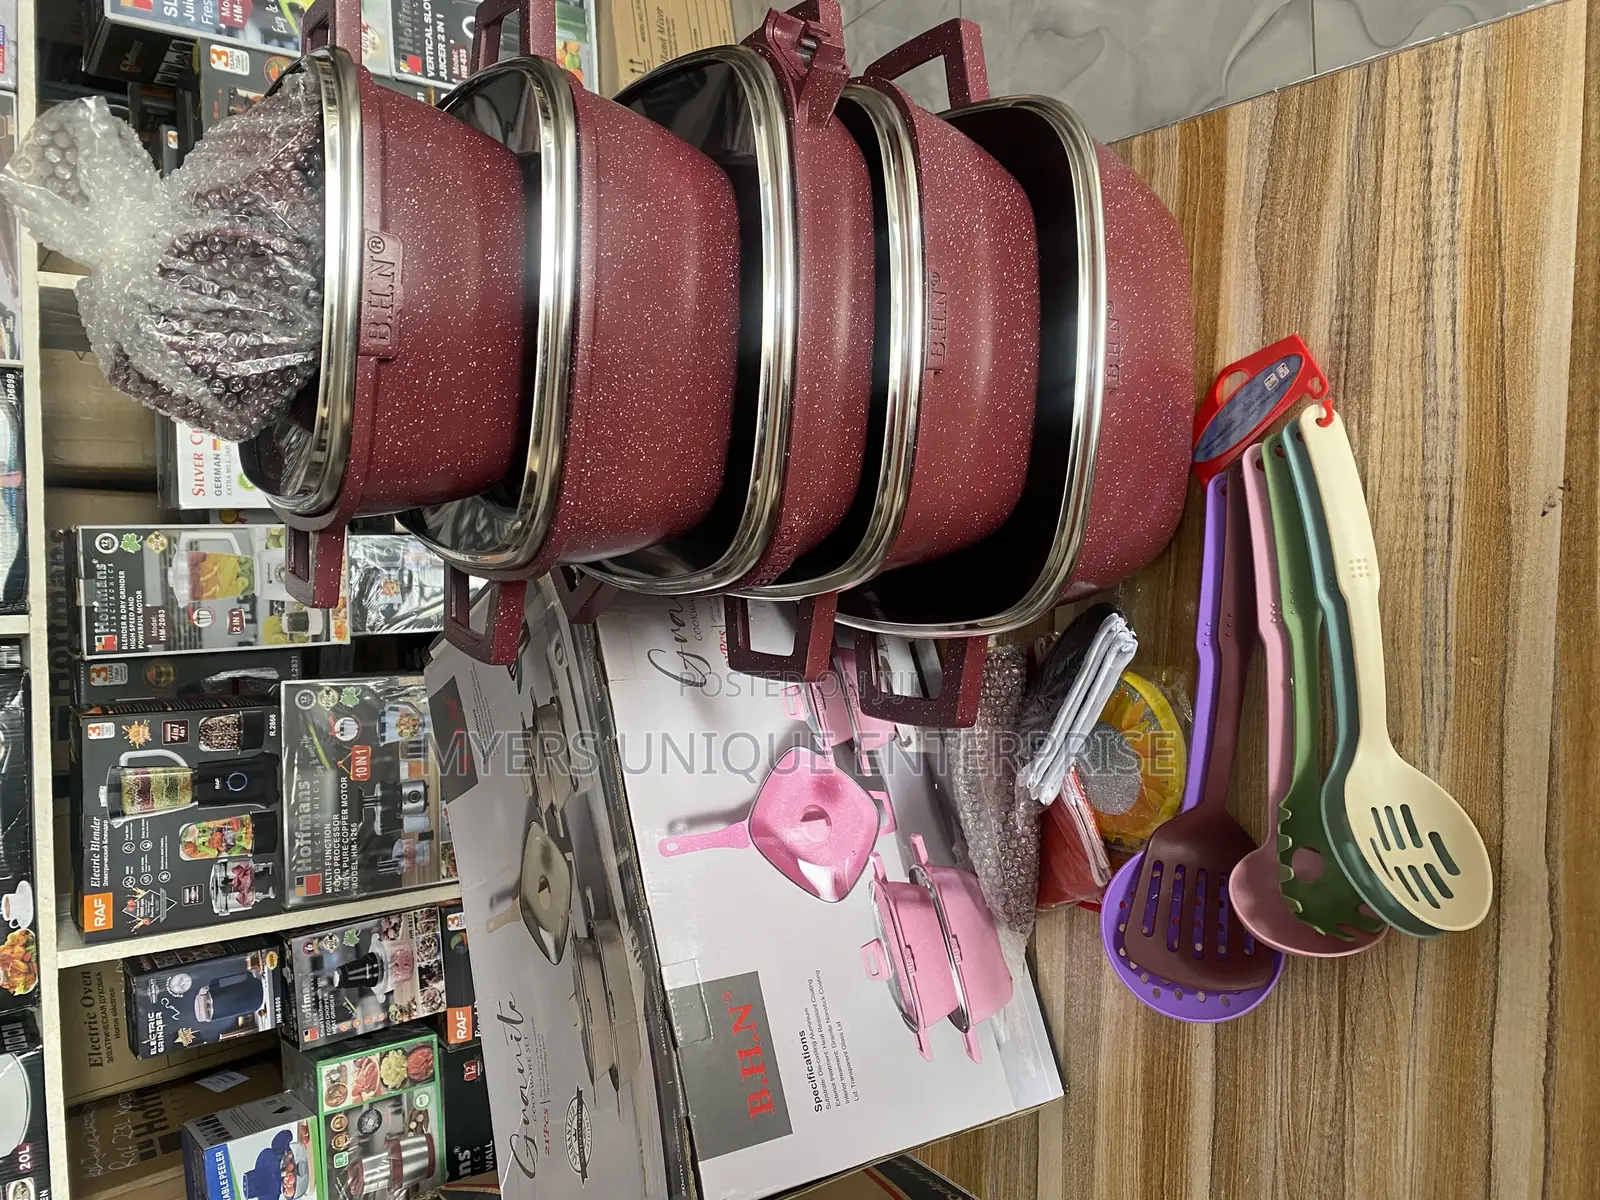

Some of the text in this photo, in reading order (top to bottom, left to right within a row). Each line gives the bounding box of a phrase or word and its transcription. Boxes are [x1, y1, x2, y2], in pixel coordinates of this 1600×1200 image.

[436, 20, 444, 32] IN
[438, 34, 445, 42] 2
[656, 6, 666, 36] Mixer
[210, 48, 229, 68] 3
[425, 26, 434, 78] VERTICAL
[438, 43, 448, 80] JUICER
[452, 48, 460, 74] Model:
[192, 452, 206, 496] SILVER
[213, 452, 222, 496] GERMAN
[102, 539, 108, 548] 12
[107, 562, 116, 632] ELECTRONICS
[233, 616, 240, 625] IN
[90, 666, 108, 682] 3
[301, 696, 307, 704] 12
[88, 726, 100, 736] 3
[356, 756, 366, 766] IN
[357, 766, 368, 778] 10
[340, 776, 348, 807] MOTOR
[295, 782, 312, 872] Hoffmans
[332, 813, 340, 866] PROCESSOR
[90, 816, 100, 887] Electric Blender
[102, 845, 110, 886] Электрический
[324, 823, 332, 893] MULTI-FUNCTION
[94, 898, 106, 927] RAF
[448, 916, 459, 926] 3
[80, 970, 104, 1068] Electric Oven
[95, 971, 114, 1064] ЭЛЕКТРИЧЕСКАЯ ДУХОВКА
[147, 1011, 158, 1055] ELECTRIC
[155, 1011, 165, 1053] GRINDER
[456, 1010, 466, 1039] RAF
[836, 1020, 844, 1031] Lid
[806, 978, 841, 1106] Exterior treatment: Heat Resistant Coating
[814, 970, 850, 1104] Interior treatment: Granite Nonstick Coating
[839, 1032, 848, 1050] Glass
[466, 1066, 474, 1076] 12
[798, 1030, 823, 1112] Specifications
[804, 1007, 832, 1110] Substrate: Die-casting Aluminium
[843, 1050, 857, 1088] Transparent
[497, 991, 538, 1179] Granite
[526, 1056, 538, 1122] COOKWARE
[542, 1108, 550, 1156] 21Pcs
[18, 1146, 30, 1170] 20L
[215, 1150, 228, 1179] PEELER
[485, 1140, 494, 1170] WALL
[672, 1108, 688, 1197] 20cm Casserole
